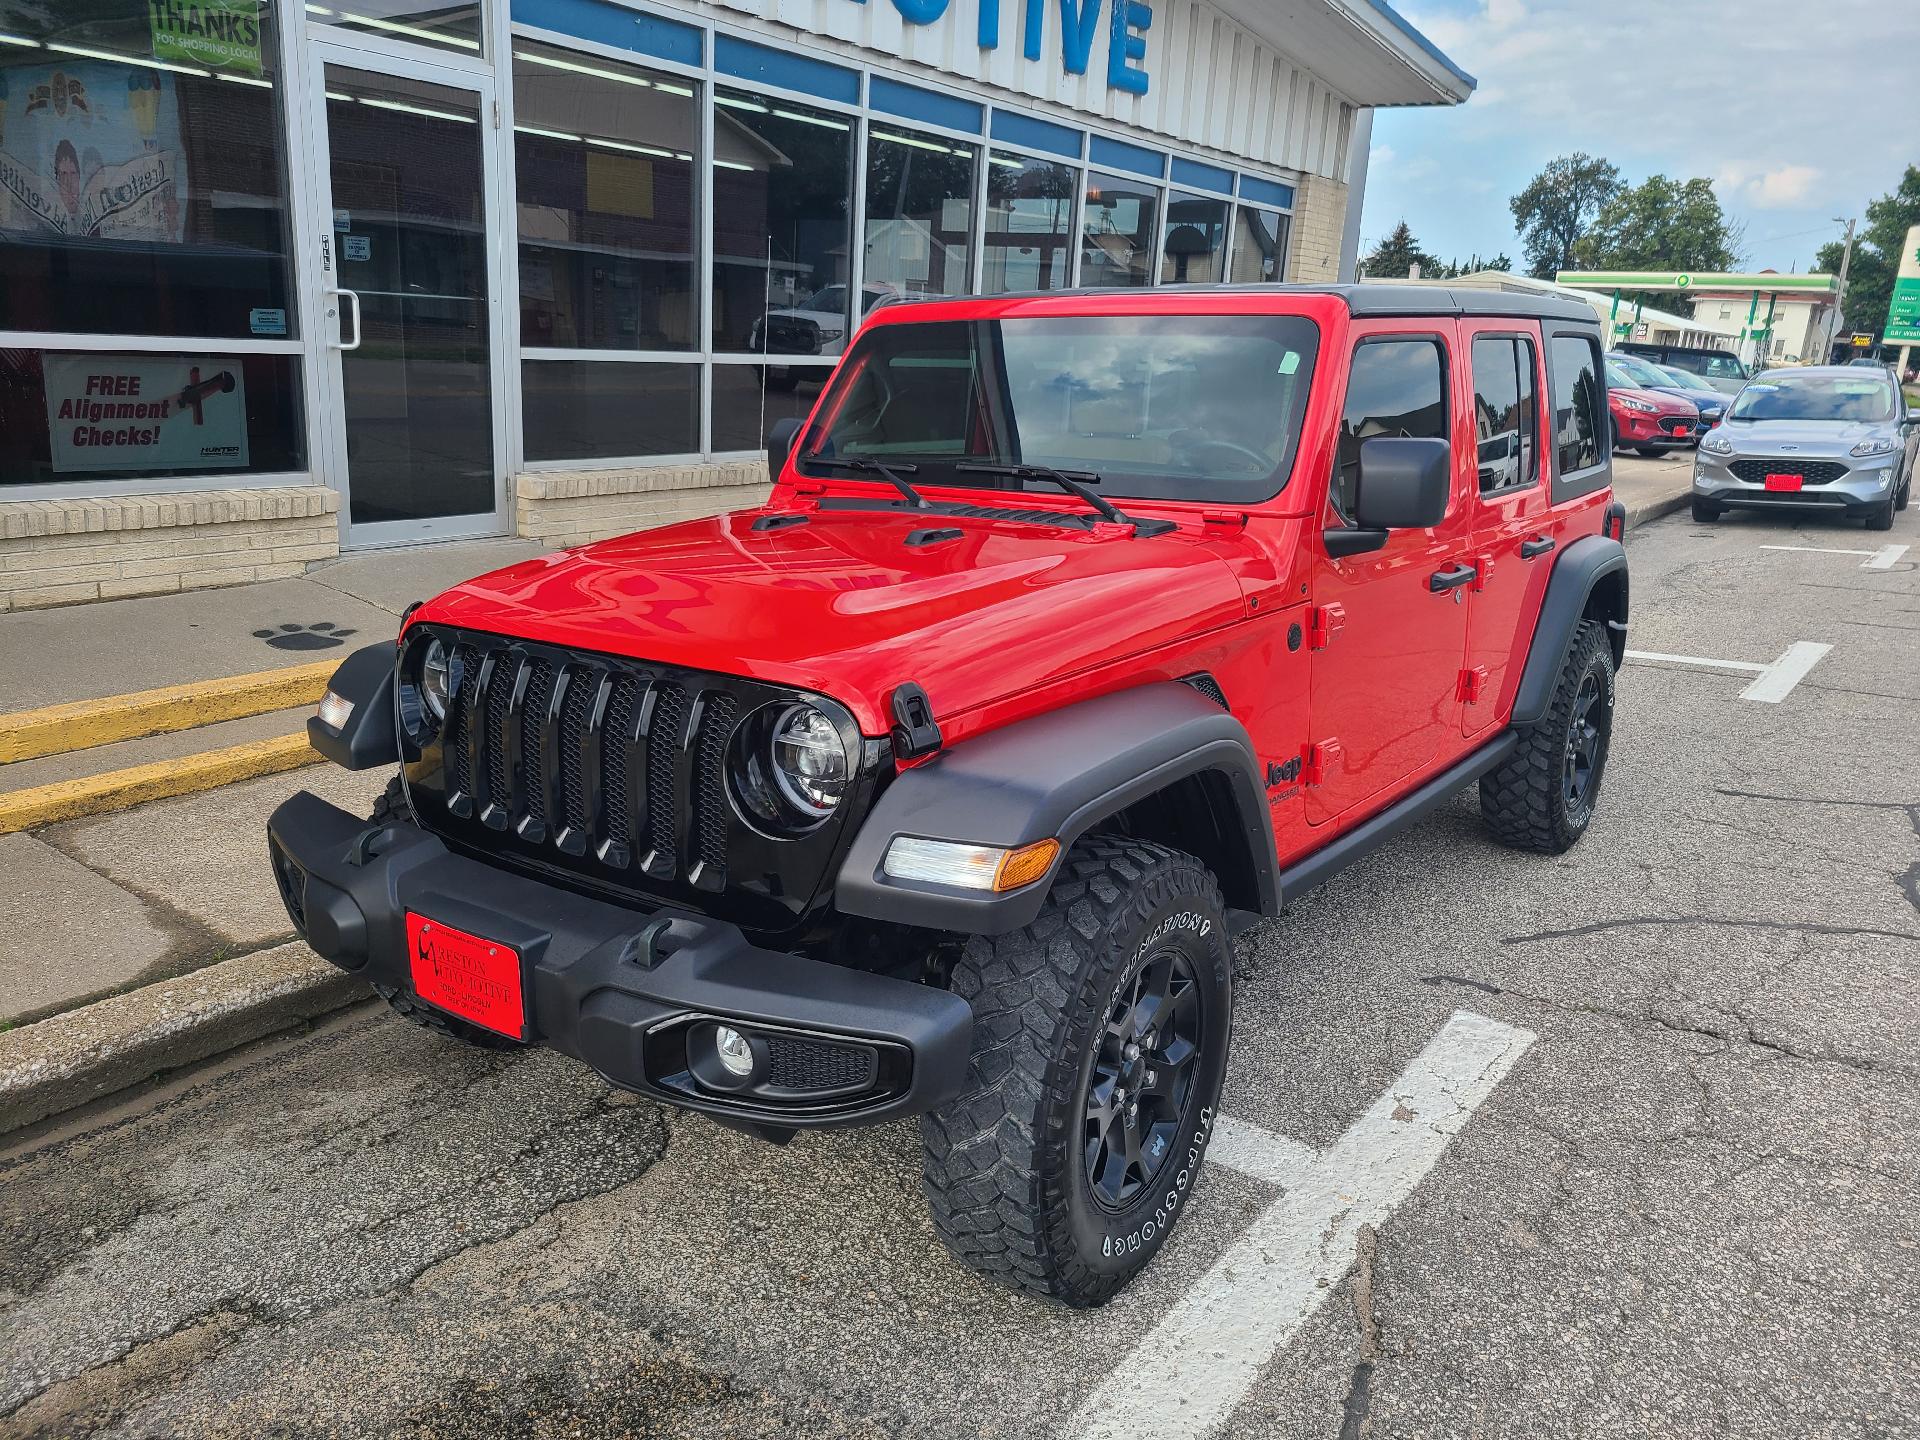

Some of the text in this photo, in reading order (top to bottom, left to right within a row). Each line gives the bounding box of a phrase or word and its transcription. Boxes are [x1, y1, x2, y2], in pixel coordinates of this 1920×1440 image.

[151, 0, 258, 47] THANKS
[156, 33, 257, 60] FOR SHOPPING LOCAL
[86, 376, 141, 396] FREE
[58, 399, 170, 423] Alignment
[73, 426, 160, 447] Checks!
[1264, 755, 1302, 790] Jeep
[1114, 1105, 1213, 1257] Firestone
